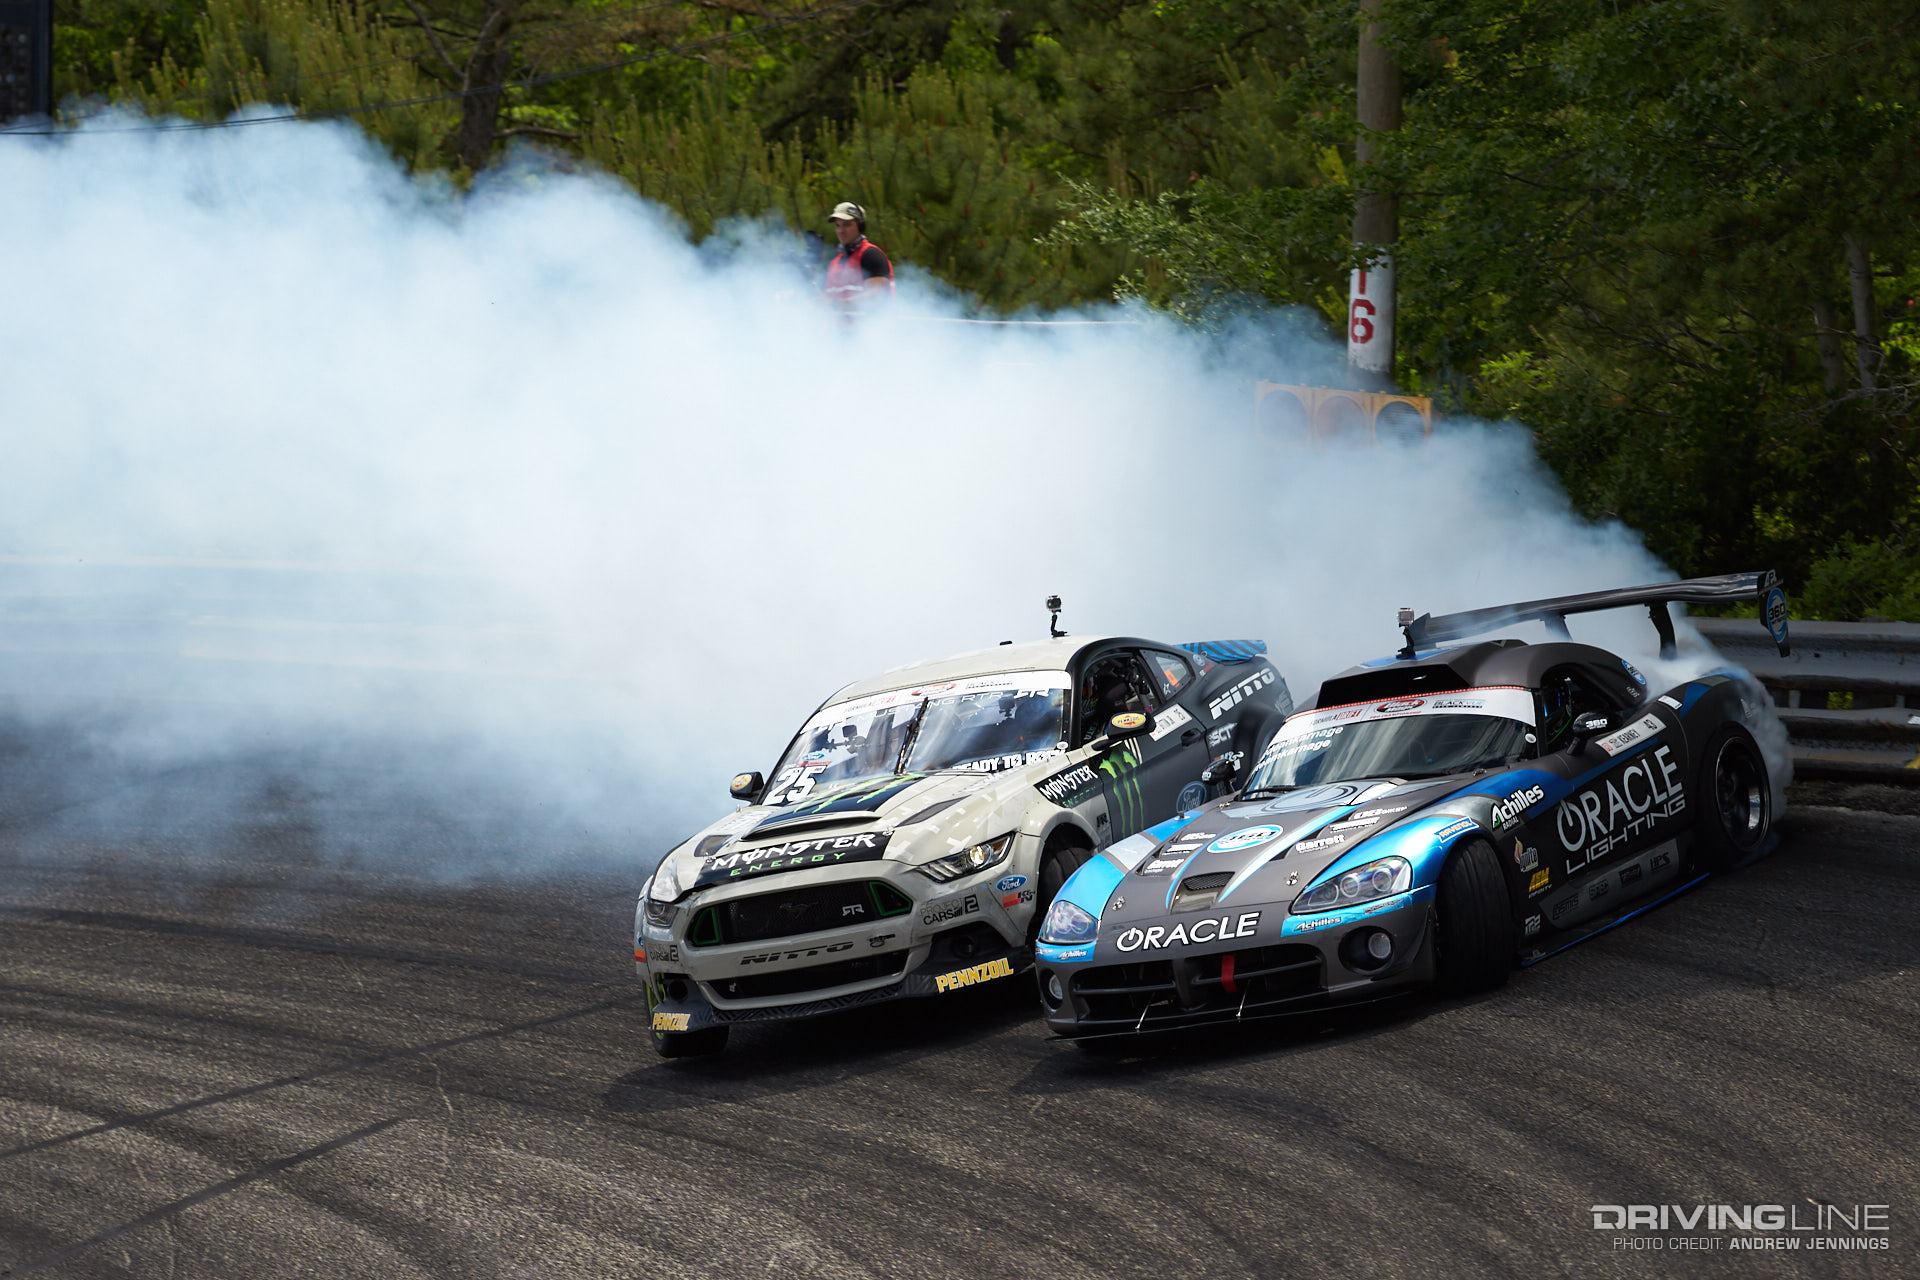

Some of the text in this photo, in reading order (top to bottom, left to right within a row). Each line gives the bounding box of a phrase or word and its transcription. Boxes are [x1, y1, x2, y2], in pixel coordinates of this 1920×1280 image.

[762, 765, 828, 806] 25
[1556, 745, 1683, 852] ORACLE
[1492, 784, 1545, 829] Achilles
[711, 833, 877, 871] MONSTER
[1565, 793, 1686, 875] LIGHTING
[729, 852, 846, 877] ENERGY
[1001, 879, 1021, 891] Ford
[923, 909, 955, 926] CARS
[1116, 912, 1260, 952] ORACLE
[1293, 917, 1341, 932] Achilles
[935, 957, 1015, 993] PENNZOIL
